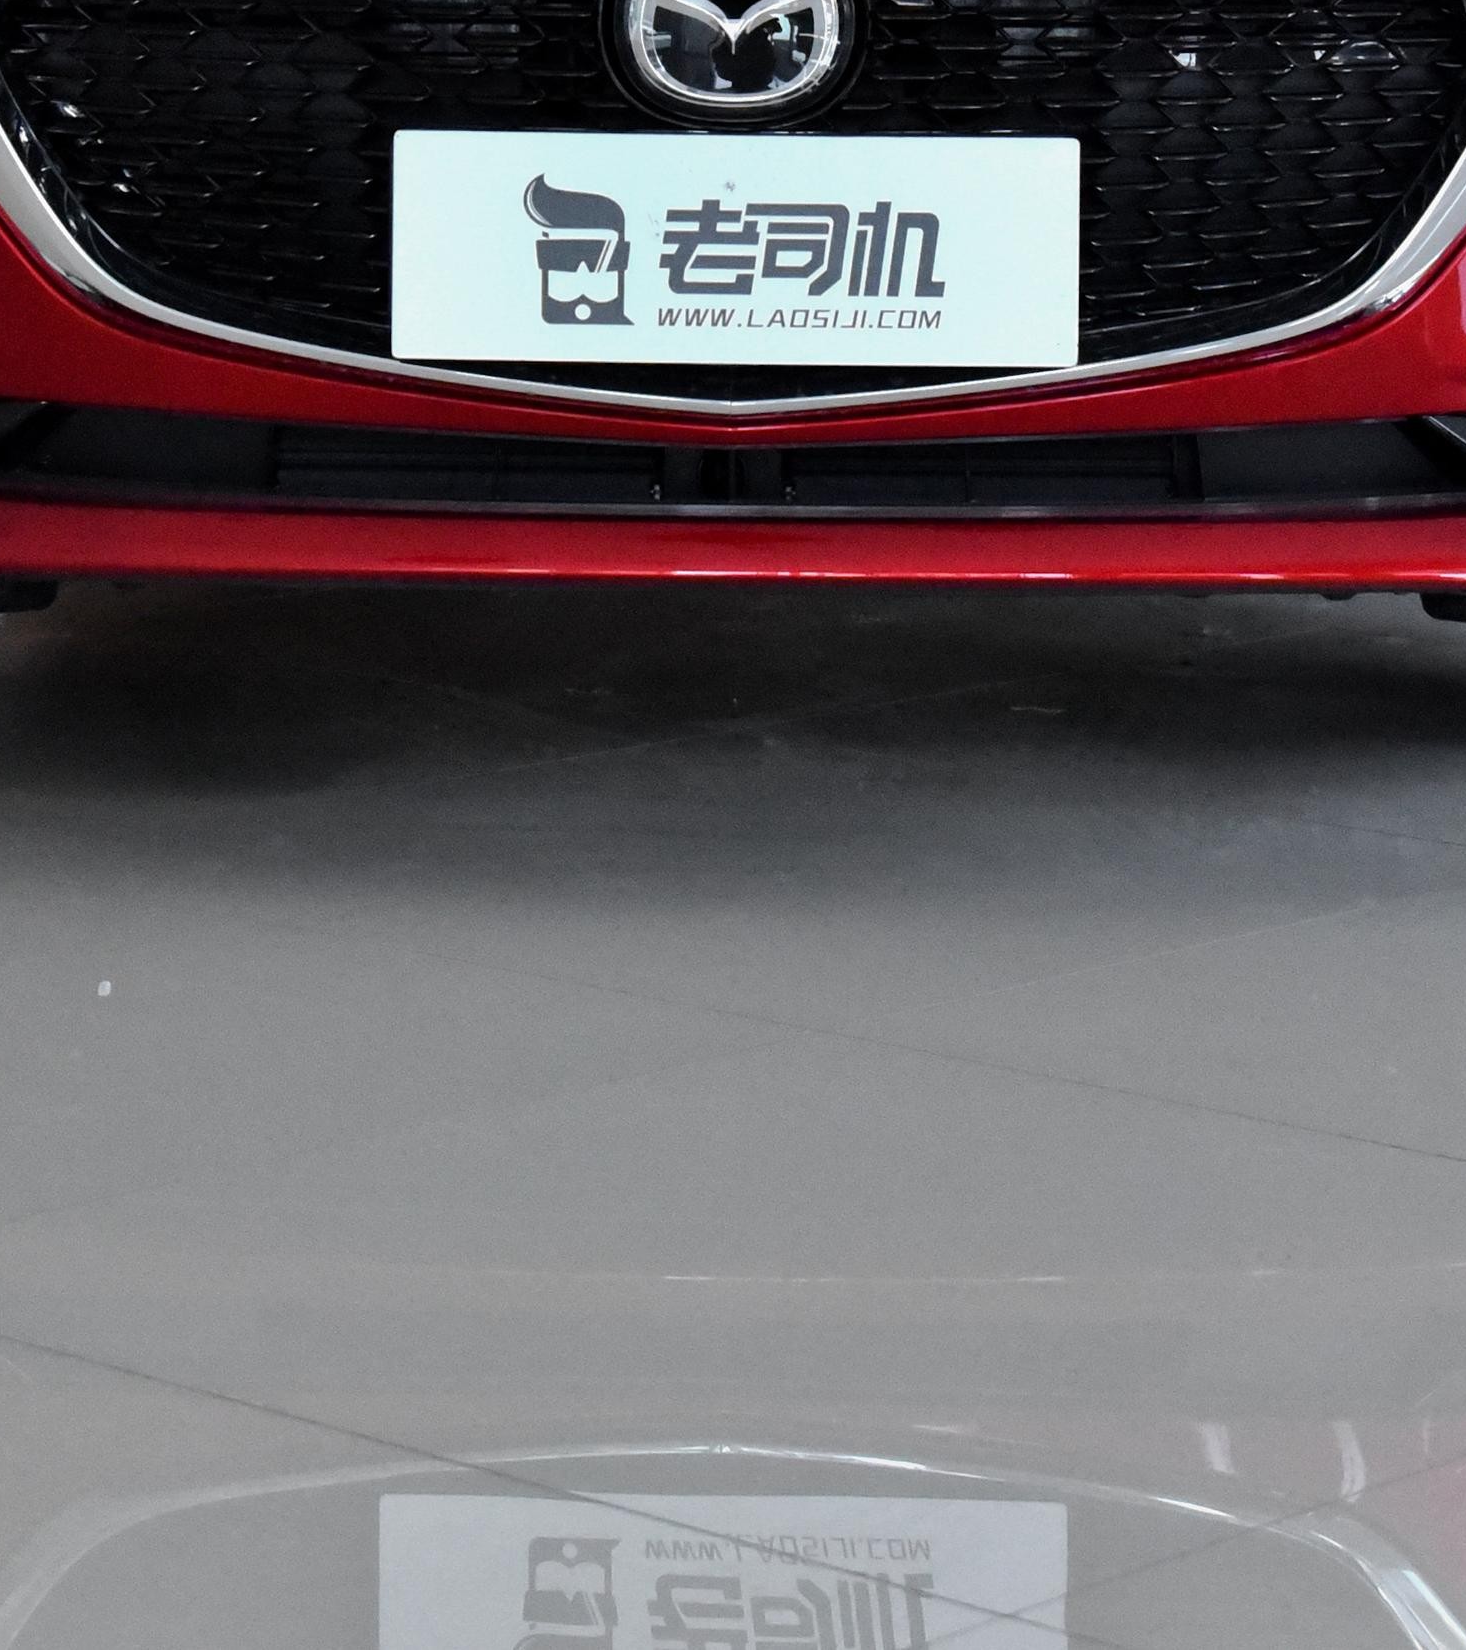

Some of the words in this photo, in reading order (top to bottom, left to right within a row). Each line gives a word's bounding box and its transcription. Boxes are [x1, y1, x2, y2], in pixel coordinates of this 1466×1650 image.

[659, 200, 945, 298] 老司机
[657, 307, 942, 330] WWW.LAOSIJI.COM
